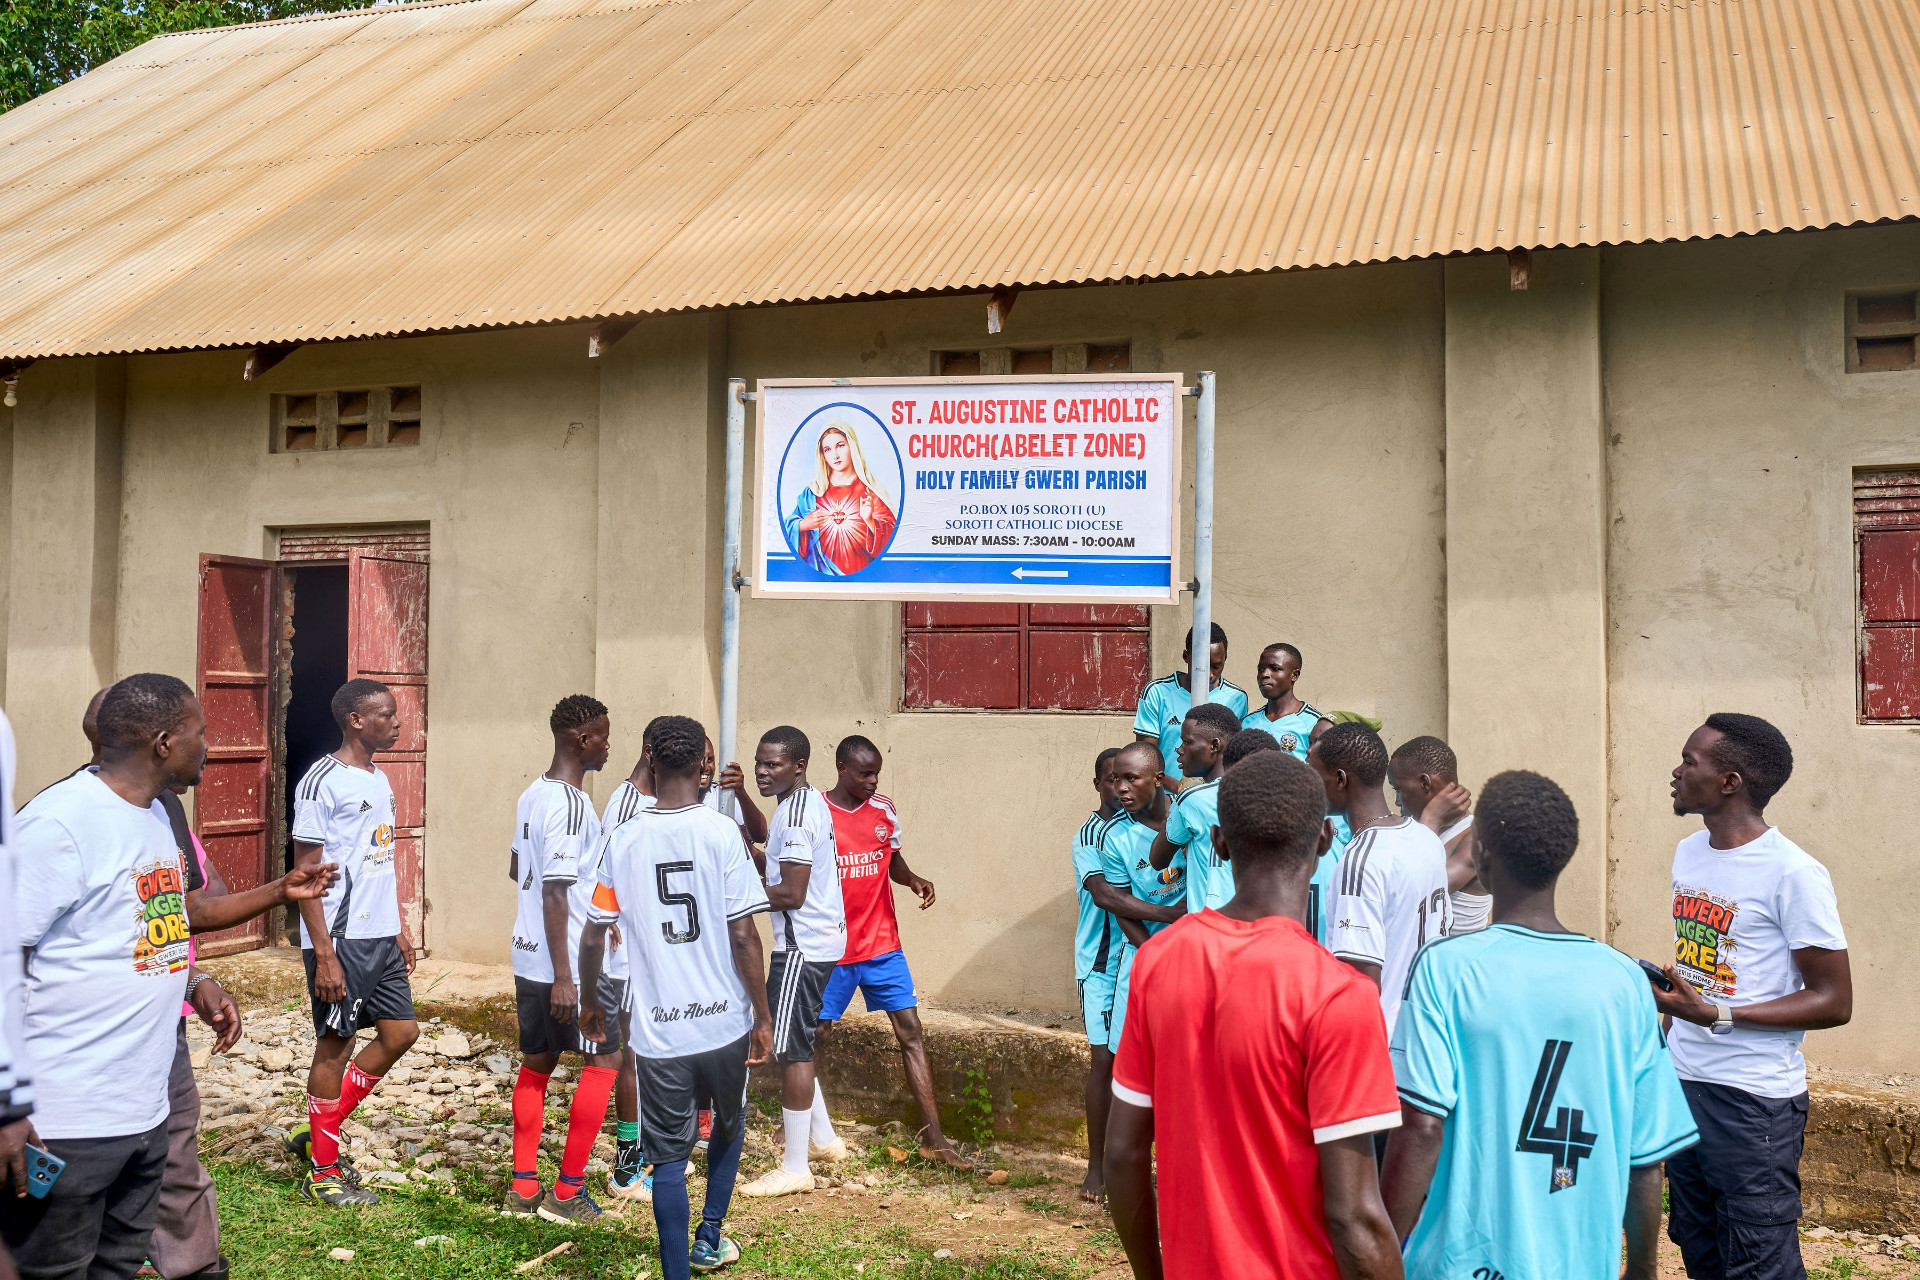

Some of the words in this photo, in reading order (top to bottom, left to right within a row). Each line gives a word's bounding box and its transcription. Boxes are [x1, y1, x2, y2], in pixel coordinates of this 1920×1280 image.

[891, 400, 922, 425] ST.
[929, 399, 1047, 424] AUGUSTINE
[1053, 397, 1159, 423] CATHOLIC
[908, 433, 1078, 460] CHURCH(ABELET
[1083, 432, 1146, 461] ZONE)
[915, 470, 955, 490] HOLY
[960, 470, 1020, 490] FAMILY
[1024, 469, 1080, 490] GWERI
[1085, 469, 1147, 490] PARISH
[960, 504, 1008, 515] P.O.BOX
[1011, 504, 1030, 515] 105
[1033, 504, 1082, 515] SOROTI
[1086, 505, 1106, 516] (U)
[945, 519, 993, 530] SOROTI
[996, 519, 1063, 530] CATHOLIC
[1066, 519, 1123, 531] DIOCESE
[931, 535, 979, 546] SUNDAY
[981, 535, 1020, 546] MASS:
[1022, 535, 1069, 547] 7:30AM
[1081, 536, 1136, 548] 10:00AM
[837, 849, 884, 866] mirates
[850, 862, 879, 879] BETTER
[656, 861, 700, 944] 5
[1673, 894, 1734, 934] GWERI
[147, 914, 190, 946] ORE
[1676, 919, 1719, 949] NGES
[514, 936, 539, 953] Abelet
[1675, 937, 1718, 974] ORE
[651, 1006, 681, 1023] Visit
[683, 999, 729, 1020] Abelet
[1515, 1039, 1599, 1194] 4
